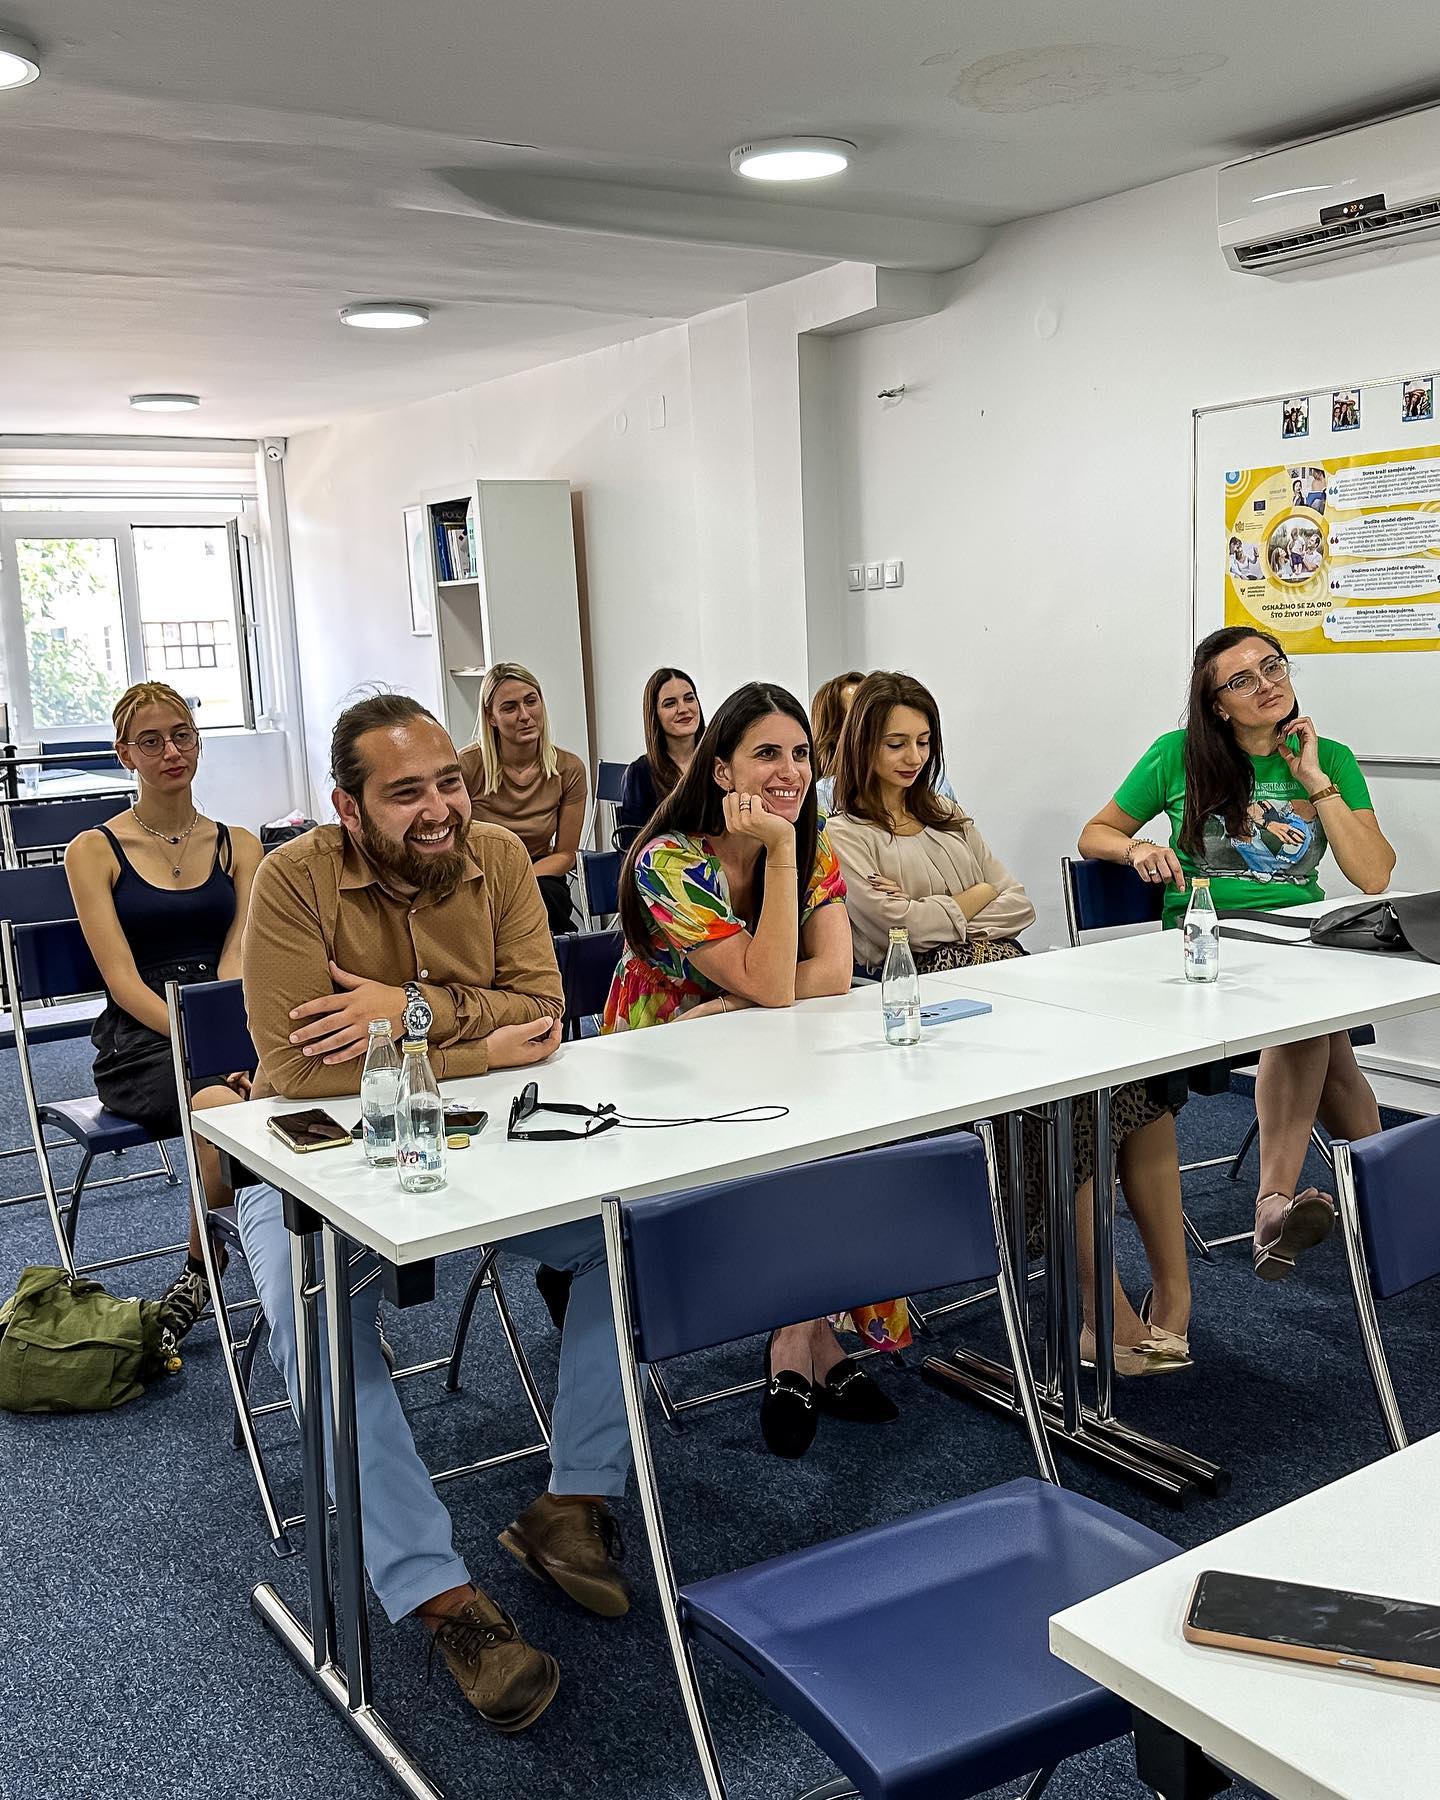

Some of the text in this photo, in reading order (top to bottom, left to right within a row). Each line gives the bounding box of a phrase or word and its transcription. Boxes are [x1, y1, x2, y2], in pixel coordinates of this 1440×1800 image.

[1261, 602, 1296, 611] OSNAŽIMO
[1270, 611, 1283, 619] ŠTO
[1284, 610, 1303, 618] ŽIVOT
